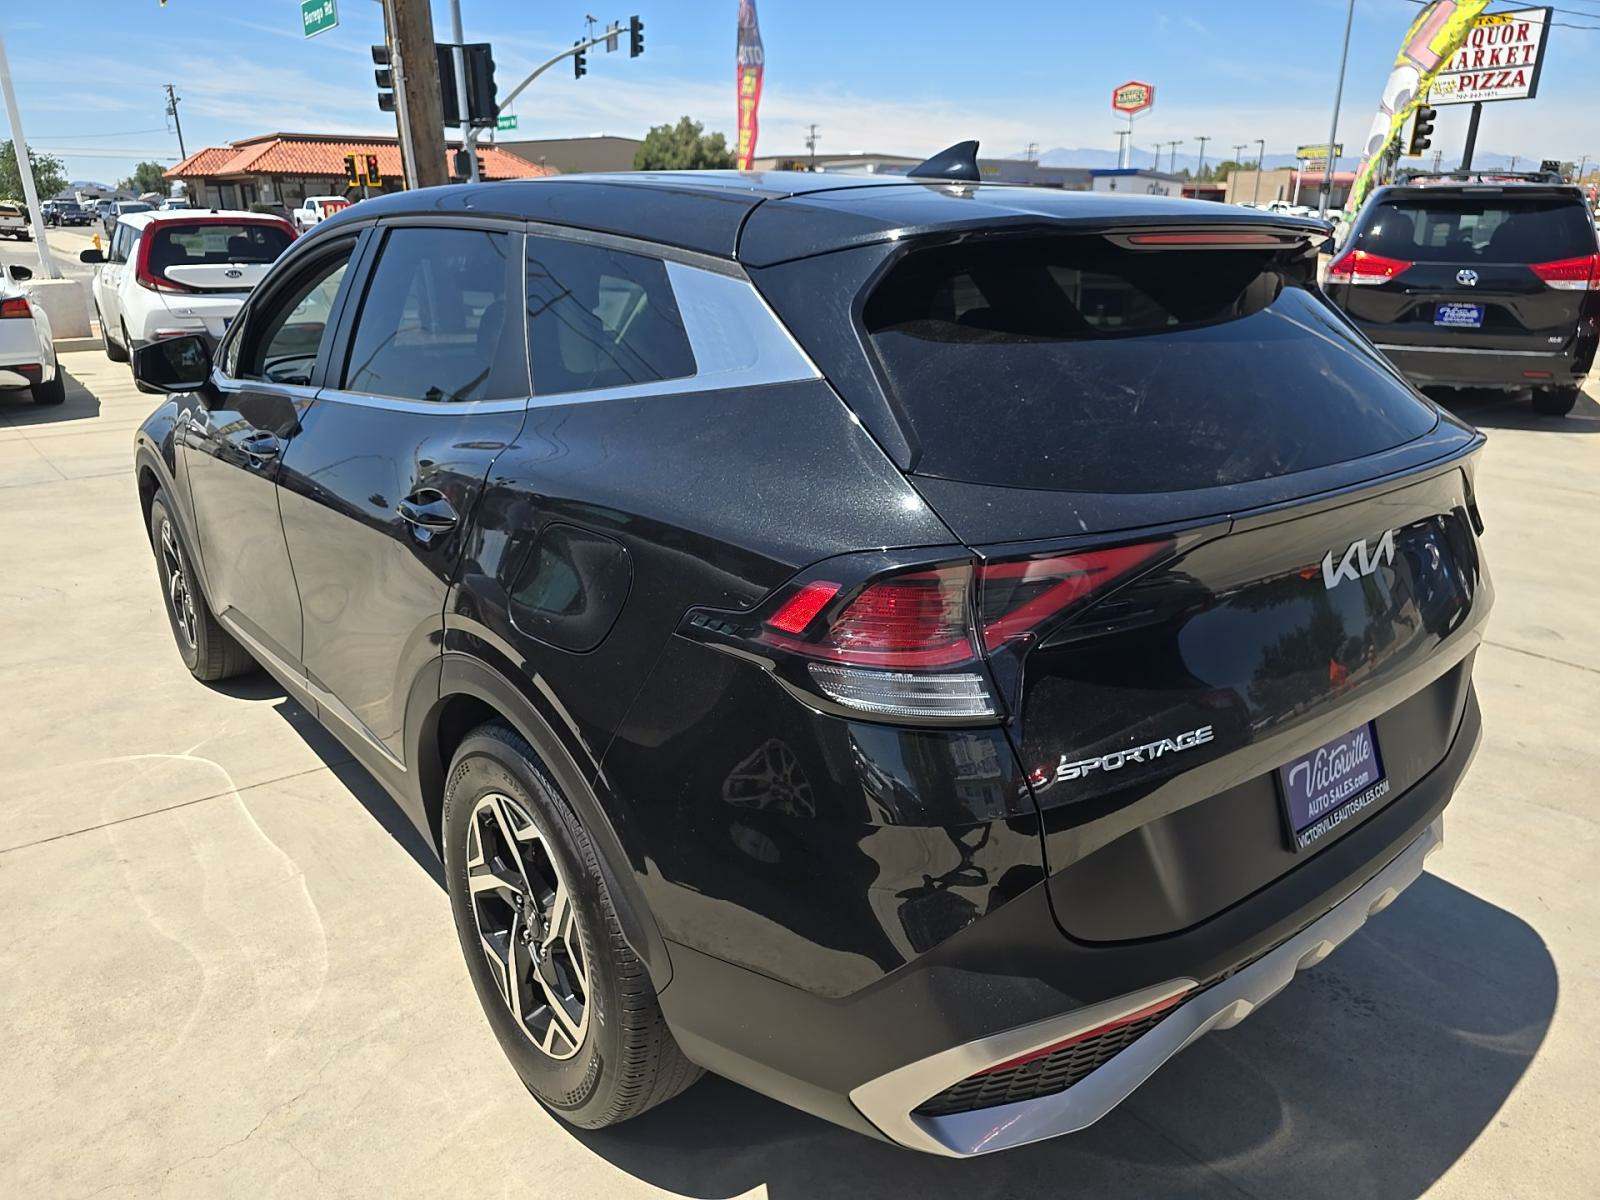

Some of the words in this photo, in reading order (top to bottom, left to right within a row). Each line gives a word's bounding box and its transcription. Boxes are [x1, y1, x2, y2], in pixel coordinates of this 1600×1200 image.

[1448, 43, 1535, 70] ARKET
[1458, 69, 1526, 92] PIZZA
[1055, 725, 1216, 783] SPORTAGE
[1288, 732, 1371, 798] Victorville
[1297, 780, 1390, 849] VICTORVILLEAUTOSALES.COM
[1308, 795, 1329, 818] AUTO
[1330, 771, 1370, 803] SALES.com
